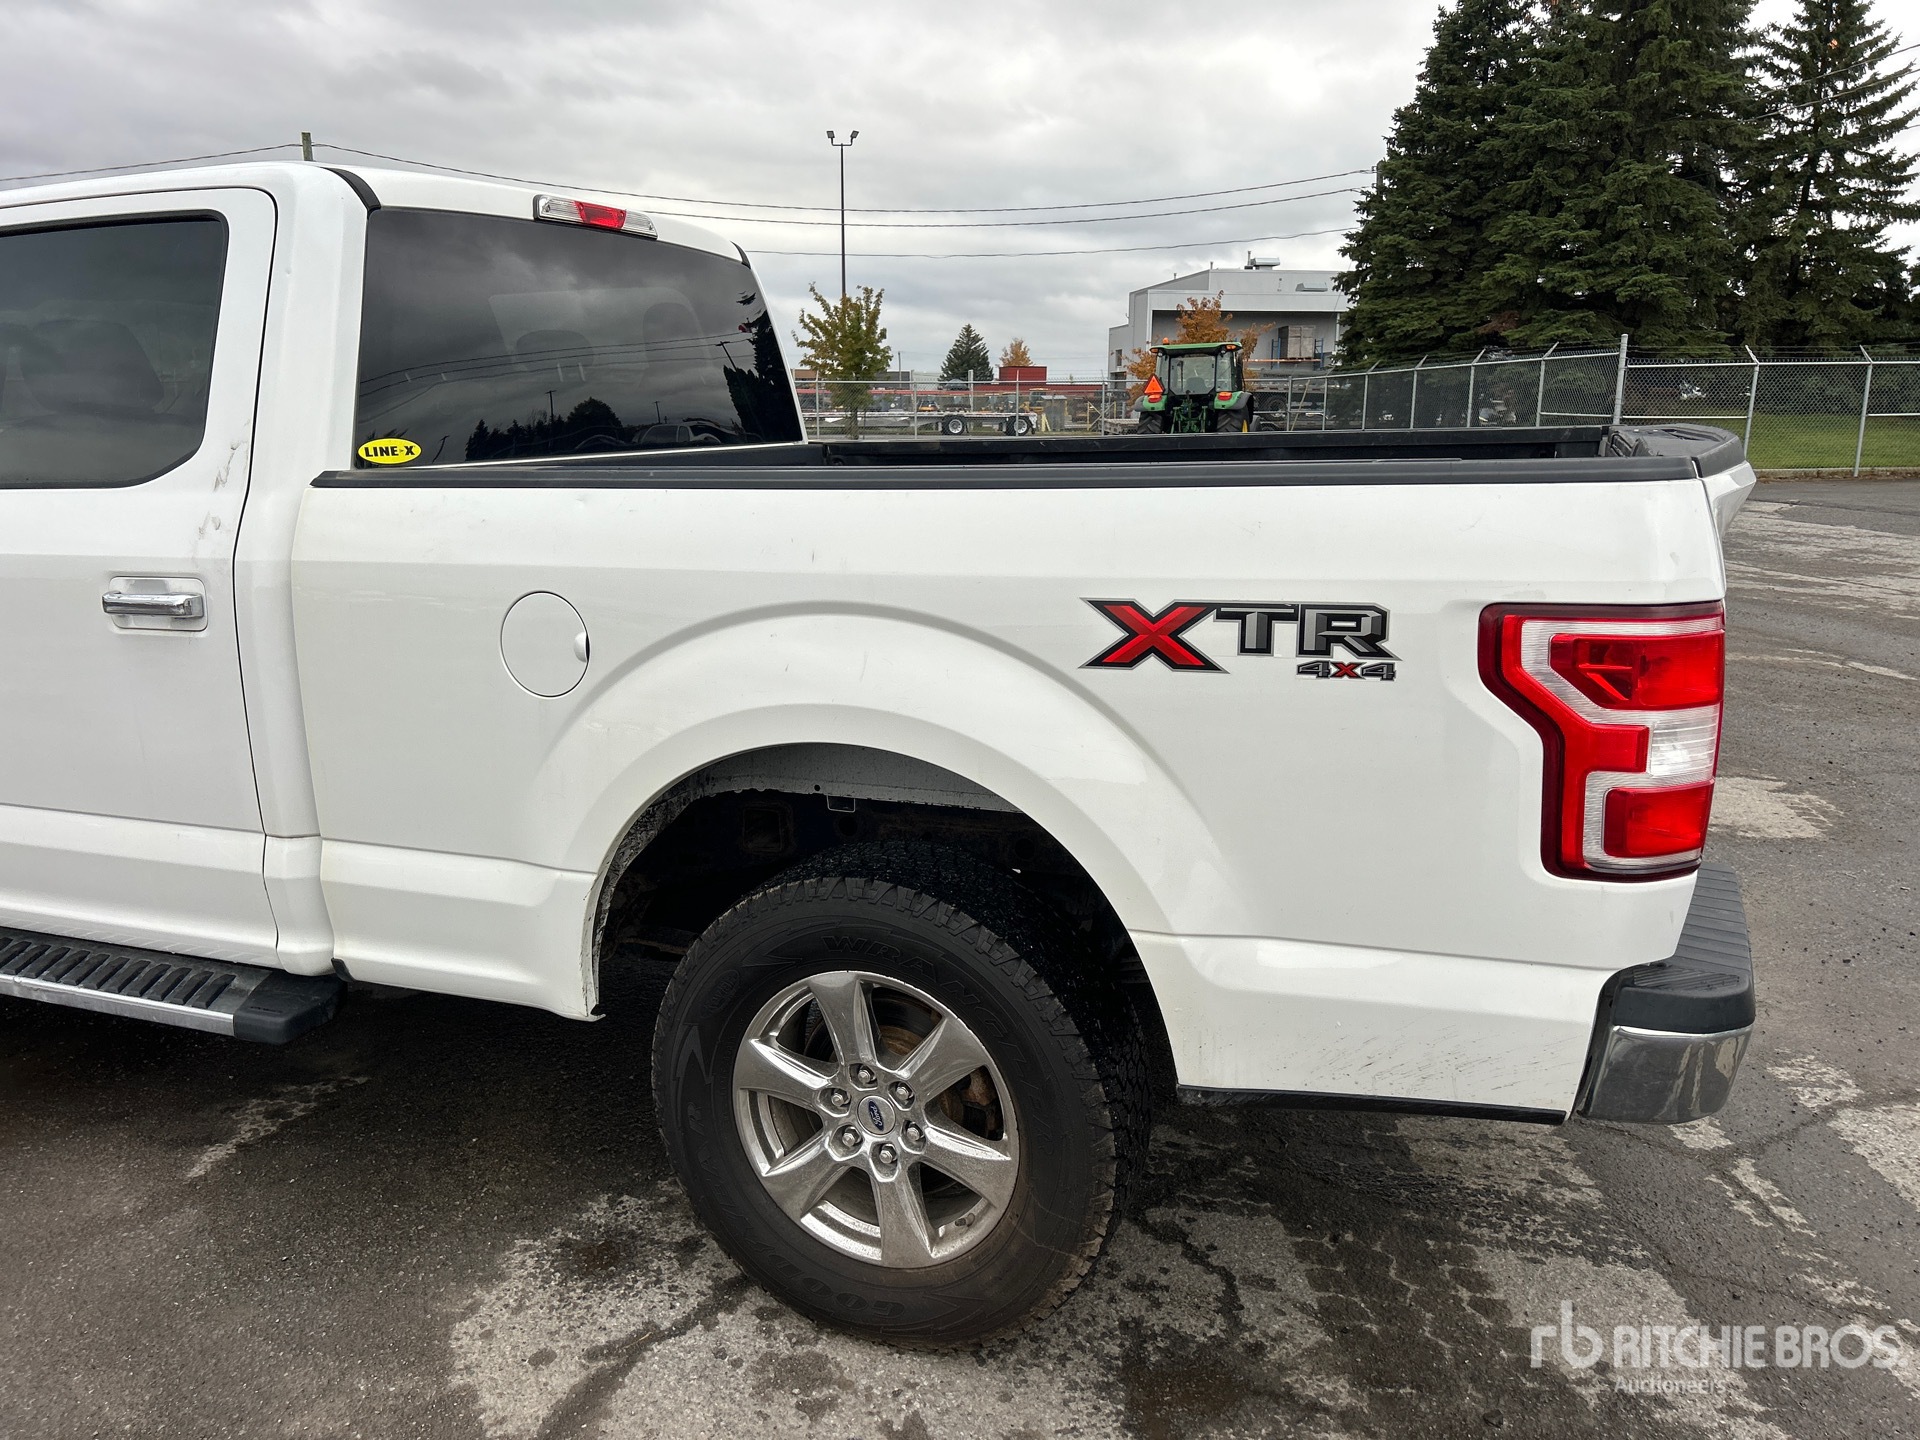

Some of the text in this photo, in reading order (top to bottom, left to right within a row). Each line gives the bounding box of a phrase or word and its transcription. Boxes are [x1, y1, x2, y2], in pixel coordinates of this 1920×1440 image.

[364, 446, 415, 457] LINE-X
[1078, 597, 1402, 674] XTR
[870, 1105, 883, 1126] Ford
